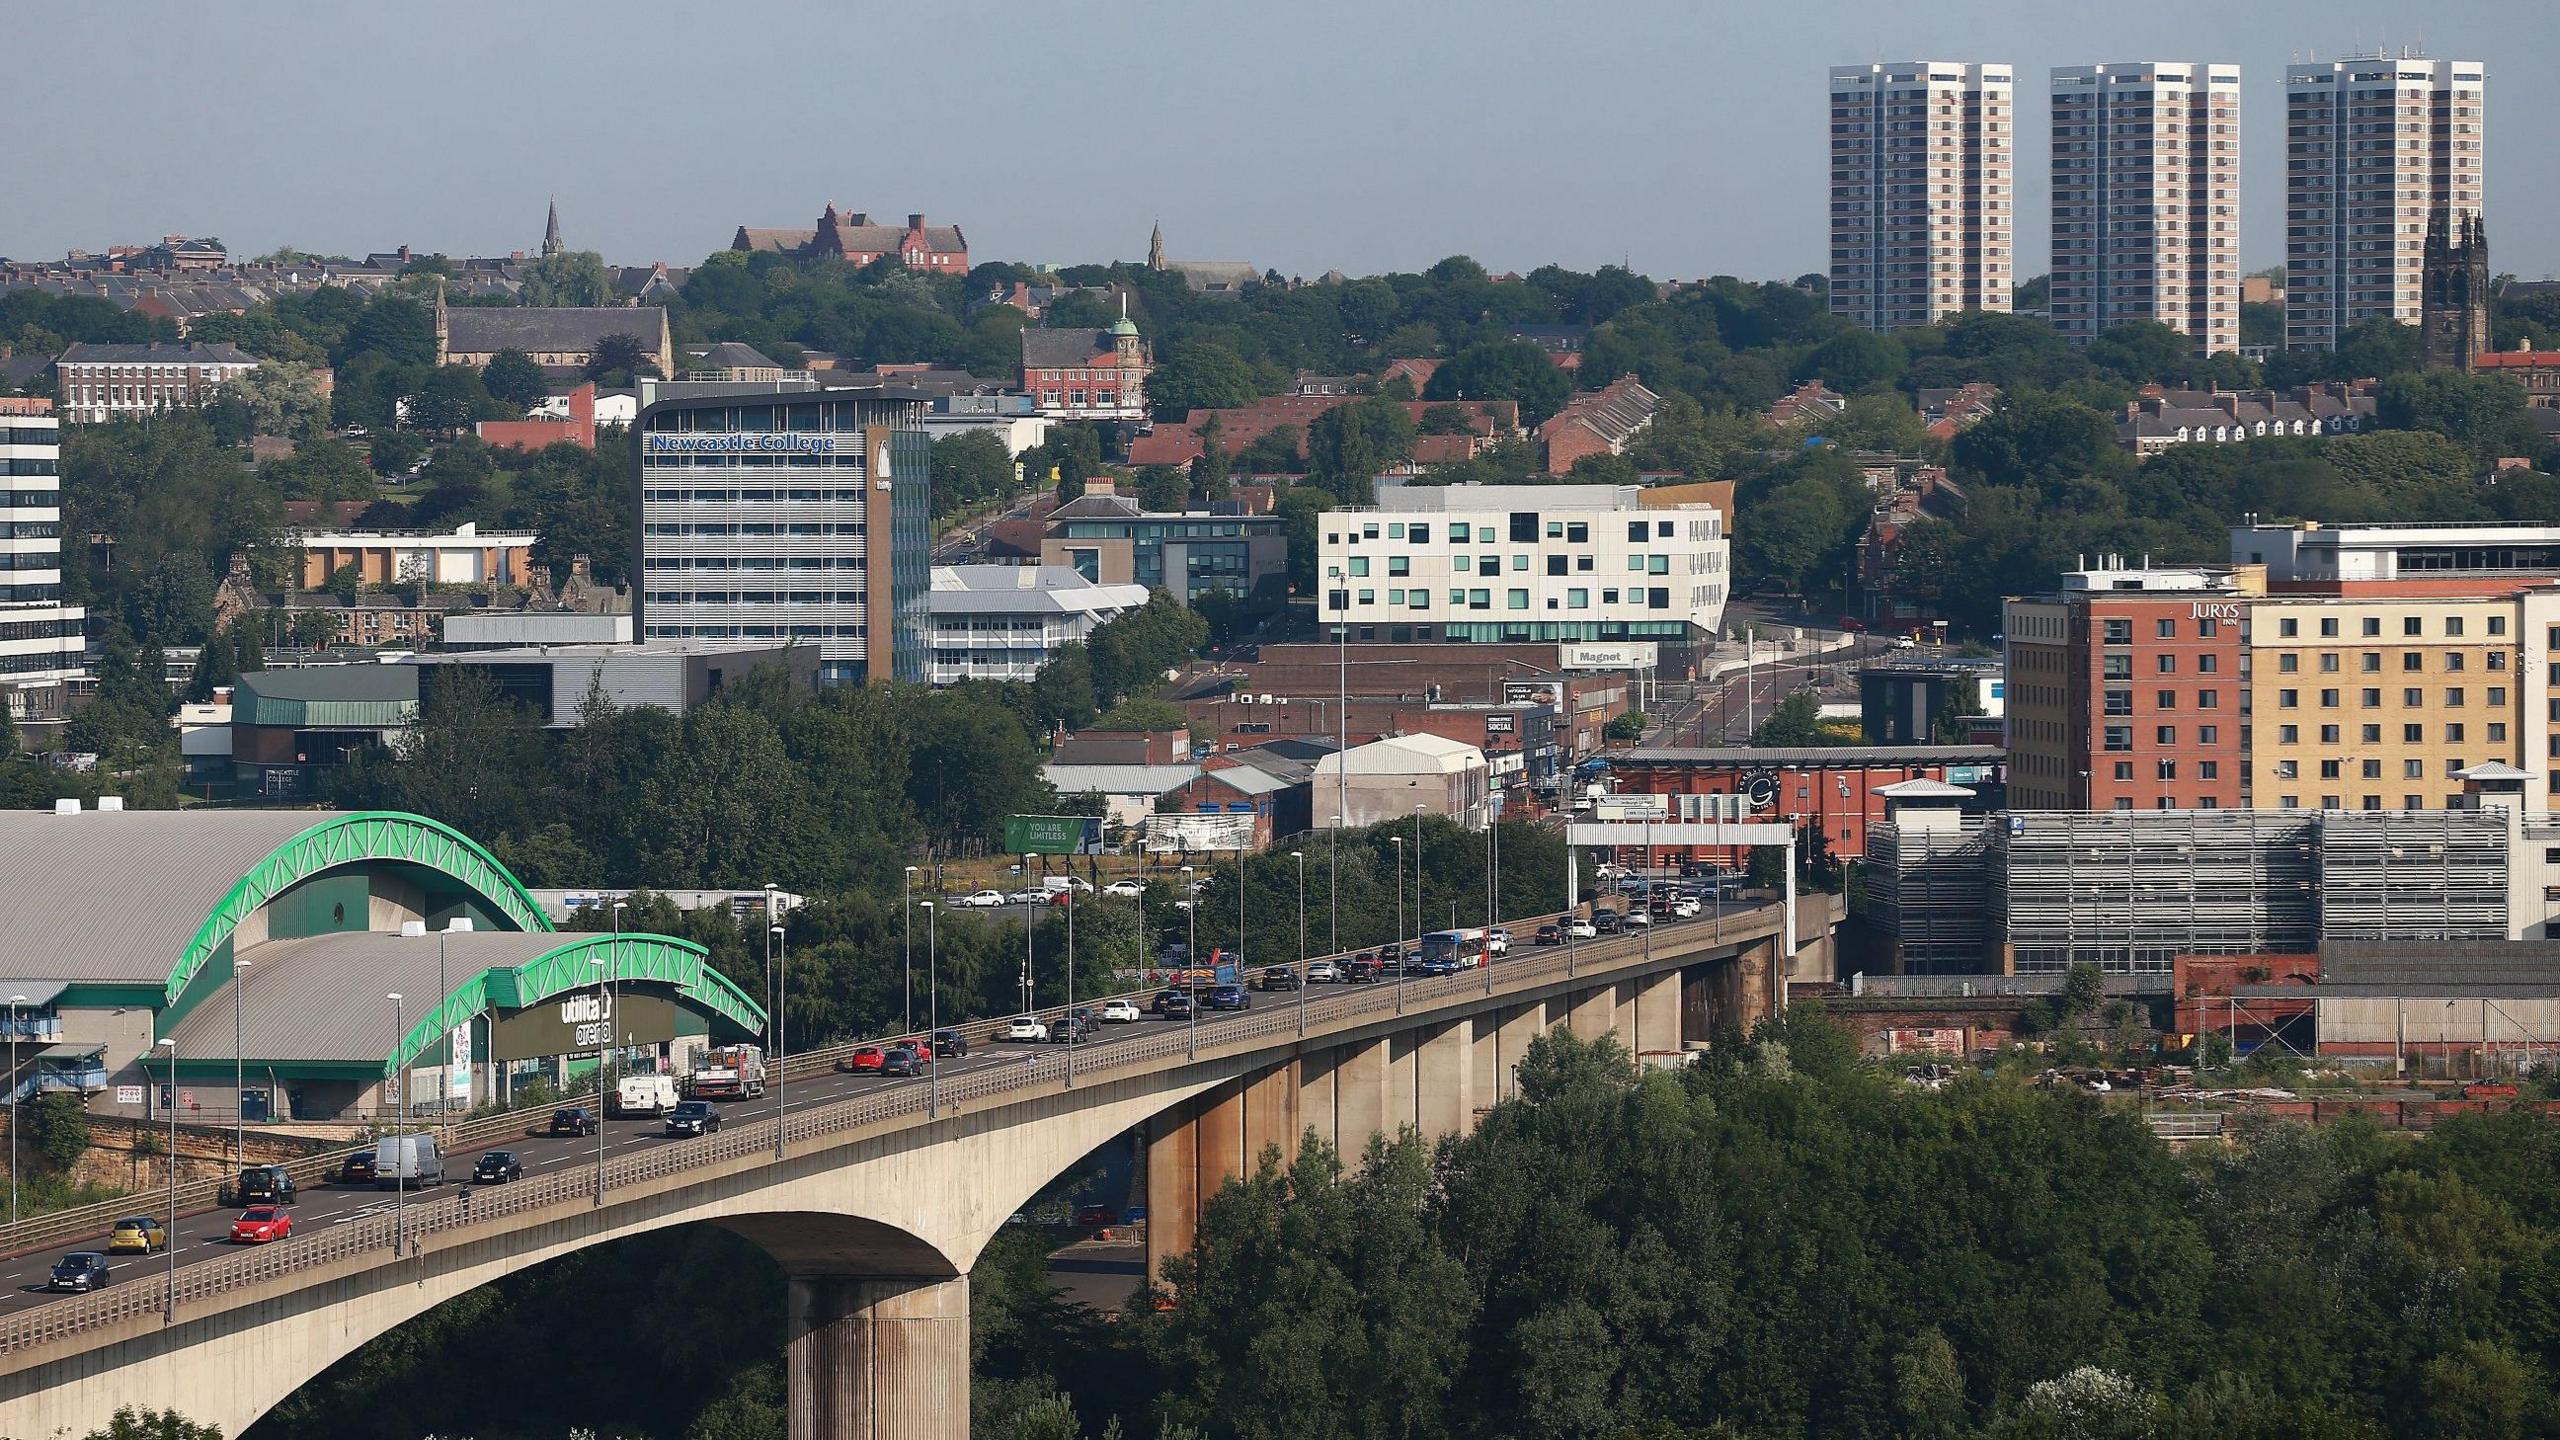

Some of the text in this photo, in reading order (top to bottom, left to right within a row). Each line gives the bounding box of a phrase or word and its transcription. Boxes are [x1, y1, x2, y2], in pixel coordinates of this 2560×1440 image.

[653, 434, 834, 454] Newcastle College
[2187, 602, 2240, 619] JURYS
[1580, 652, 1621, 663] Magnet
[1488, 723, 1513, 731] SOCIAL
[1029, 823, 1046, 832] YOU
[1047, 823, 1062, 832] ARE
[1029, 831, 1067, 841] LIMITLESS
[561, 993, 600, 1024] utilita
[576, 1021, 611, 1047] arena
